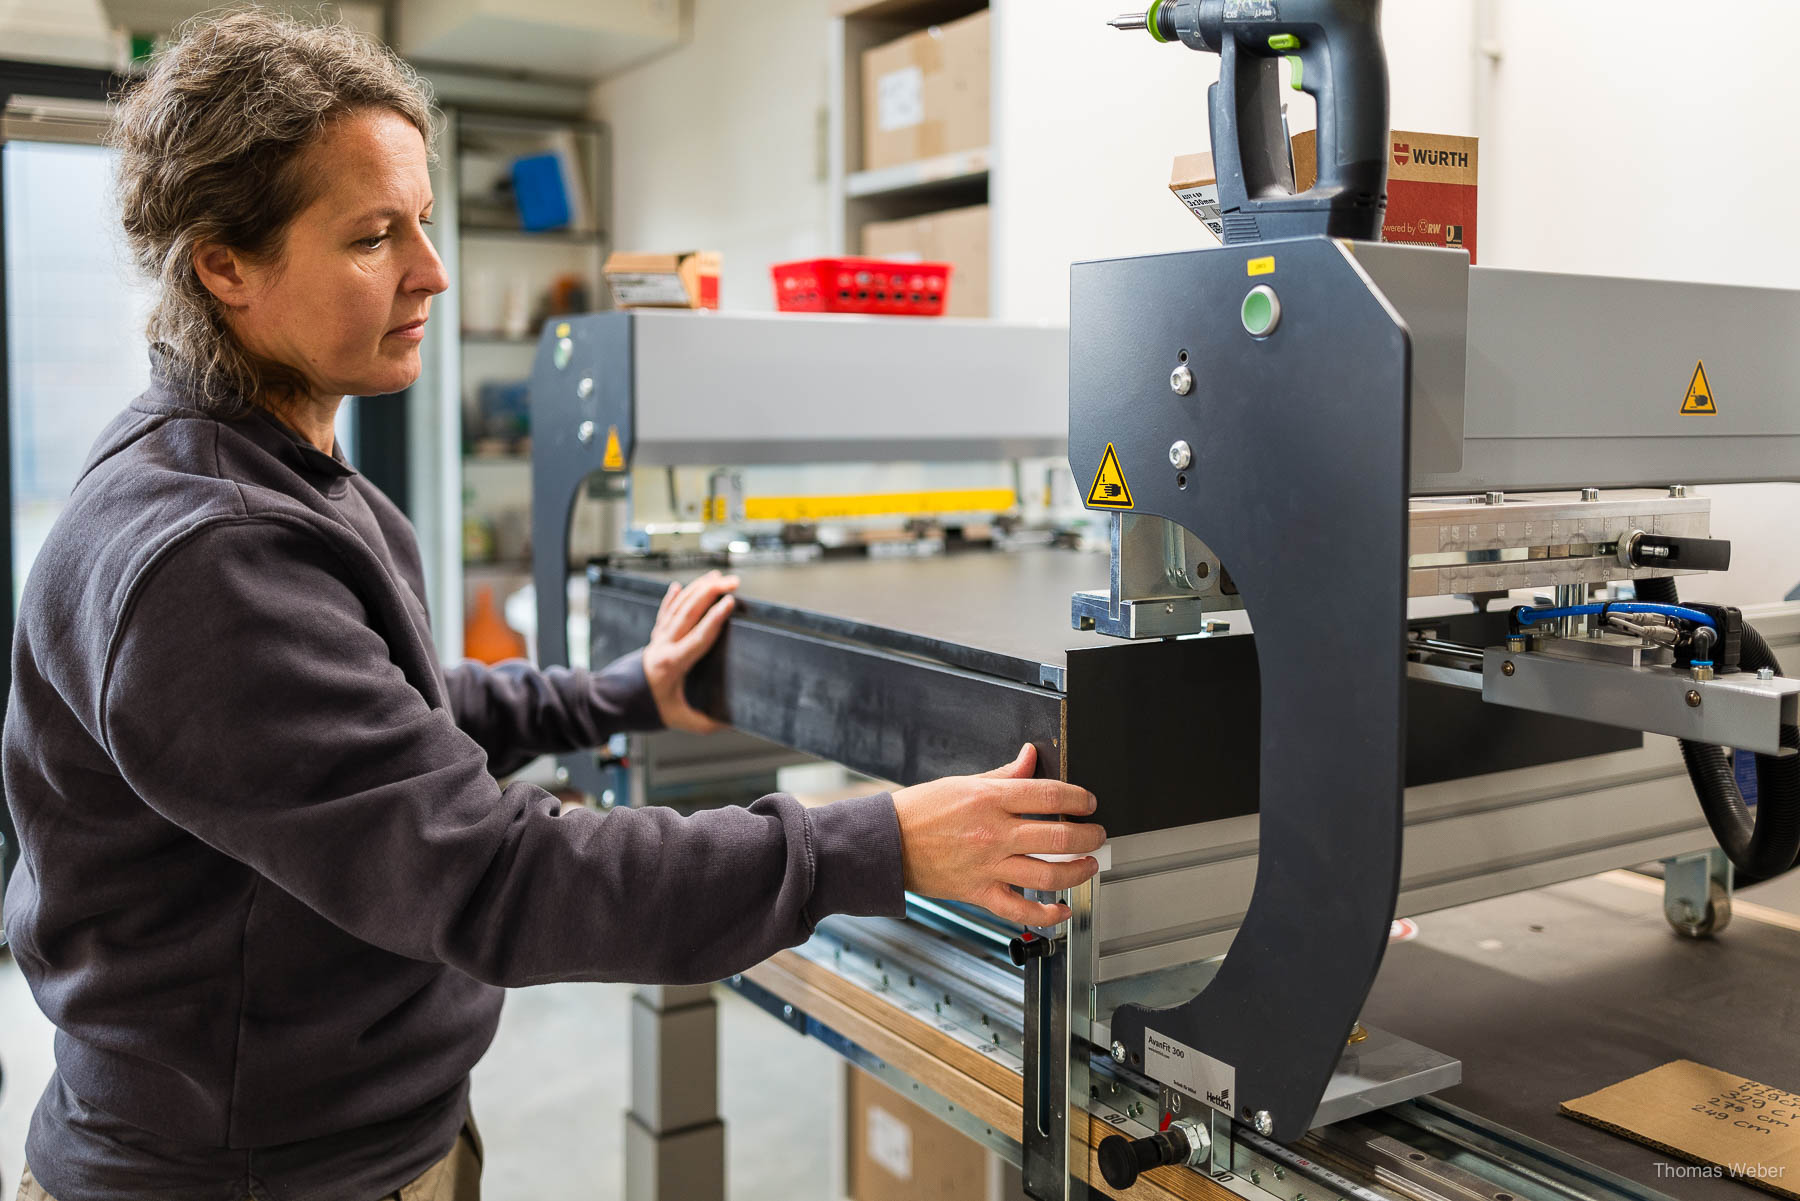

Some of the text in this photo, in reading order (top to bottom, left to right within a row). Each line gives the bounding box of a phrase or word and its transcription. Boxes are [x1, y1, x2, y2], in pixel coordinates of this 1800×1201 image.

[1413, 149, 1468, 168] WÜRTH
[1382, 222, 1406, 233] owered
[1407, 222, 1416, 236] by
[1148, 1035, 1185, 1059] AvanFit 300
[1163, 1088, 1181, 1114] 19
[1206, 1091, 1231, 1111] Hettich
[1721, 1090, 1766, 1109] 329
[1104, 1113, 1127, 1125] 80
[1691, 1104, 1729, 1120] 249
[1708, 1097, 1790, 1128] 279 cm
